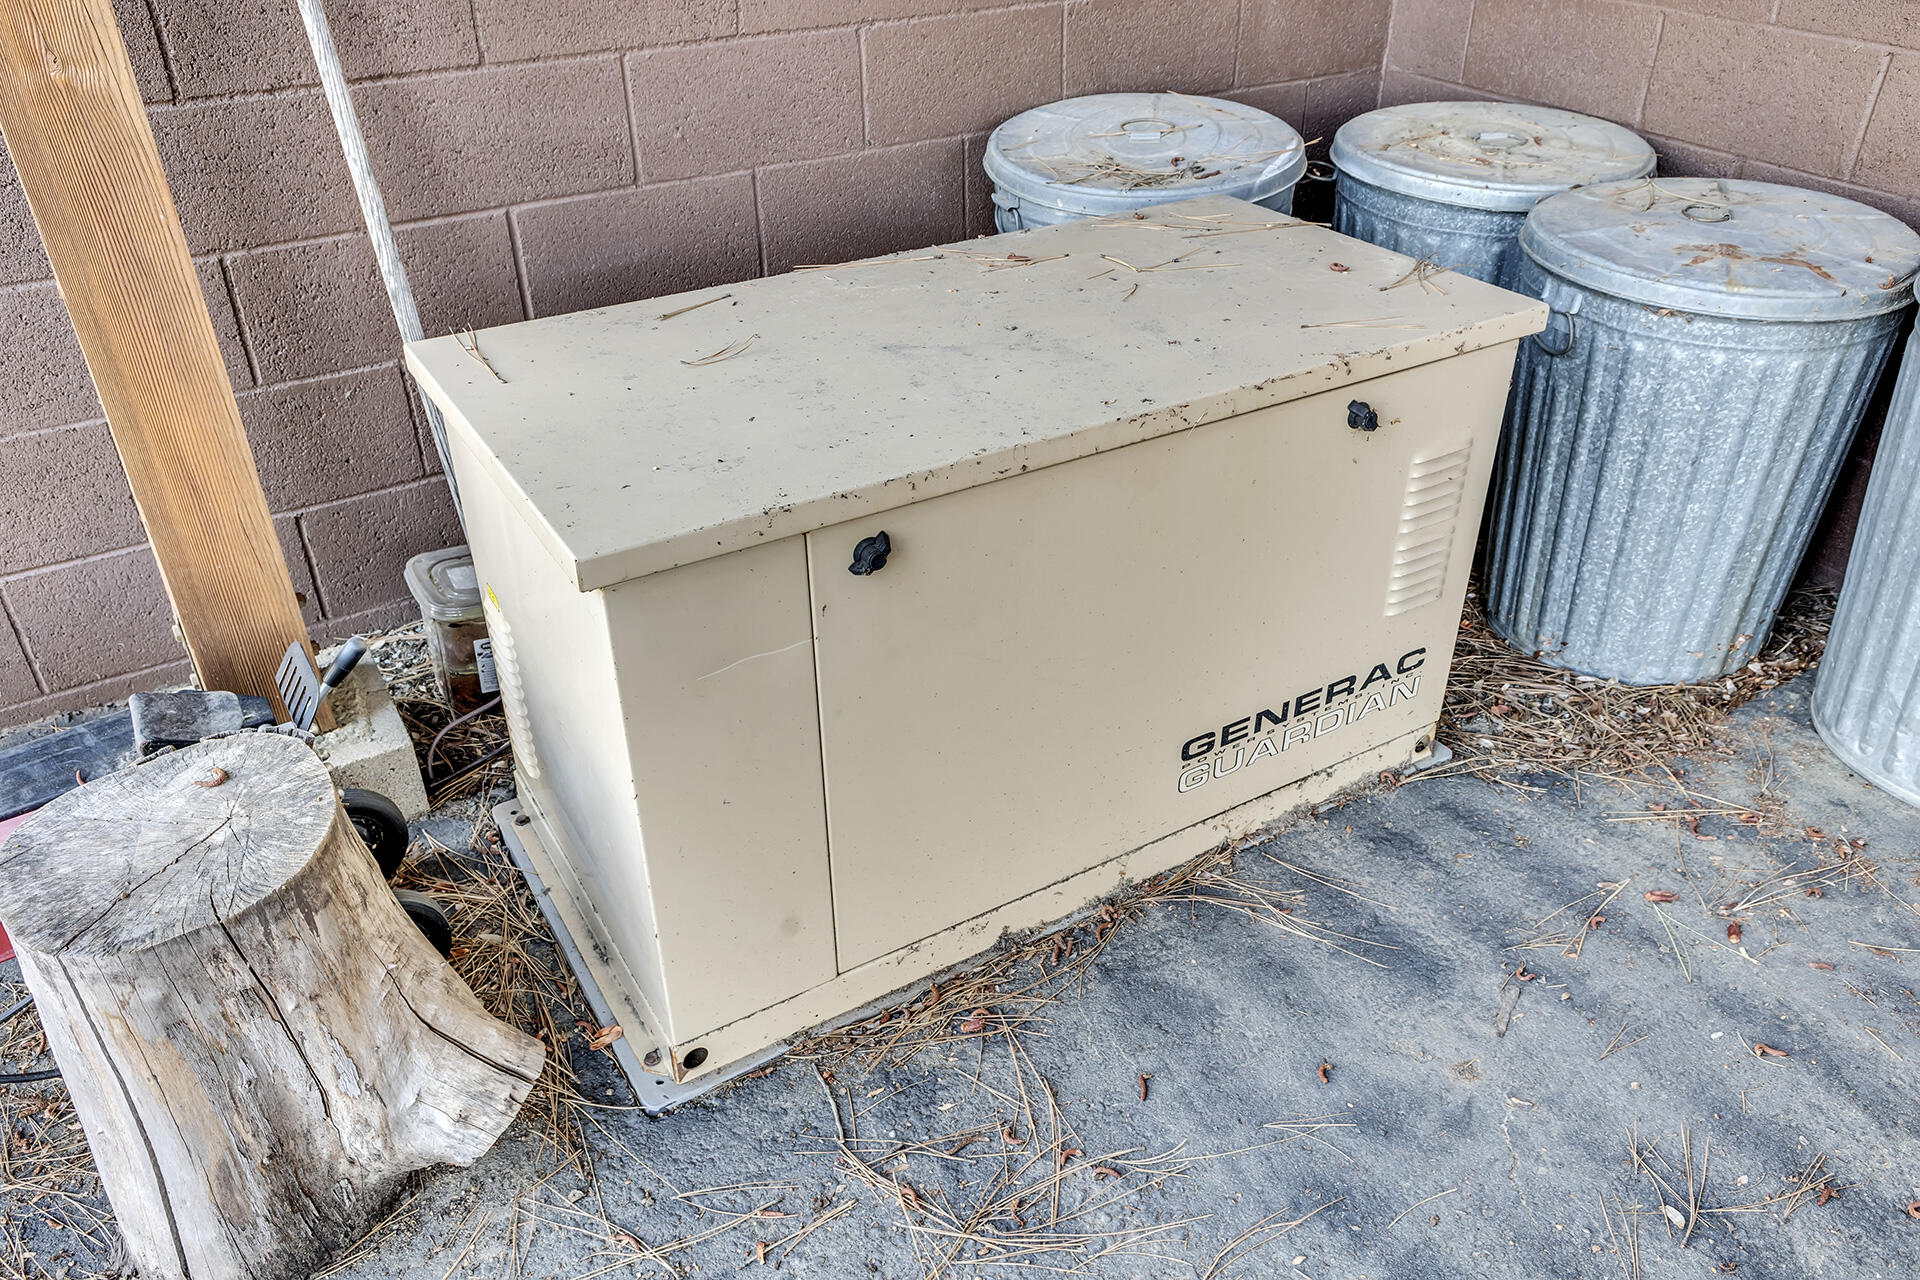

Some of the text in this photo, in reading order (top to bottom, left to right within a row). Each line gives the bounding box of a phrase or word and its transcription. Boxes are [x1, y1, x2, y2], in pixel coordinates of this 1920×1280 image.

[1178, 676, 1422, 793] GUARDIAN
[1181, 647, 1427, 762] GENERAC
[1182, 737, 1255, 769] POWER
